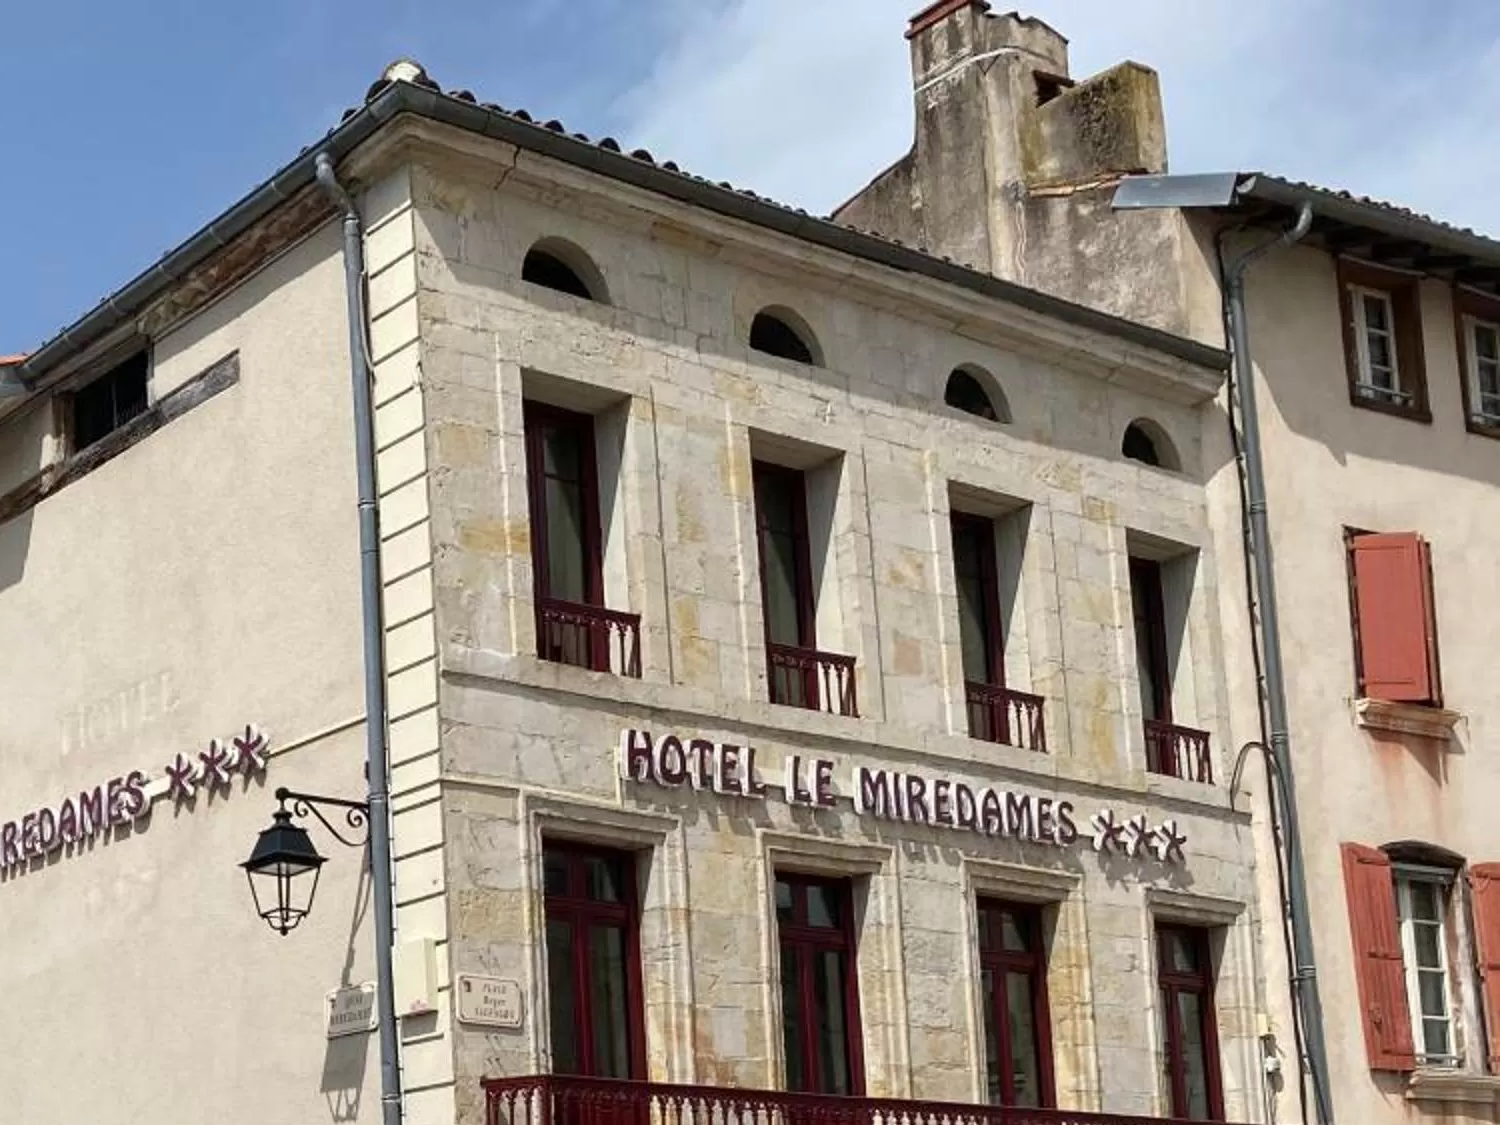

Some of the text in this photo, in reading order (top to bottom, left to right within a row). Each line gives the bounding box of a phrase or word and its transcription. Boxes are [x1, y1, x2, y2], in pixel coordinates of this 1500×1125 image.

[617, 728, 1080, 848] HOTEL LE MIREDAMES
